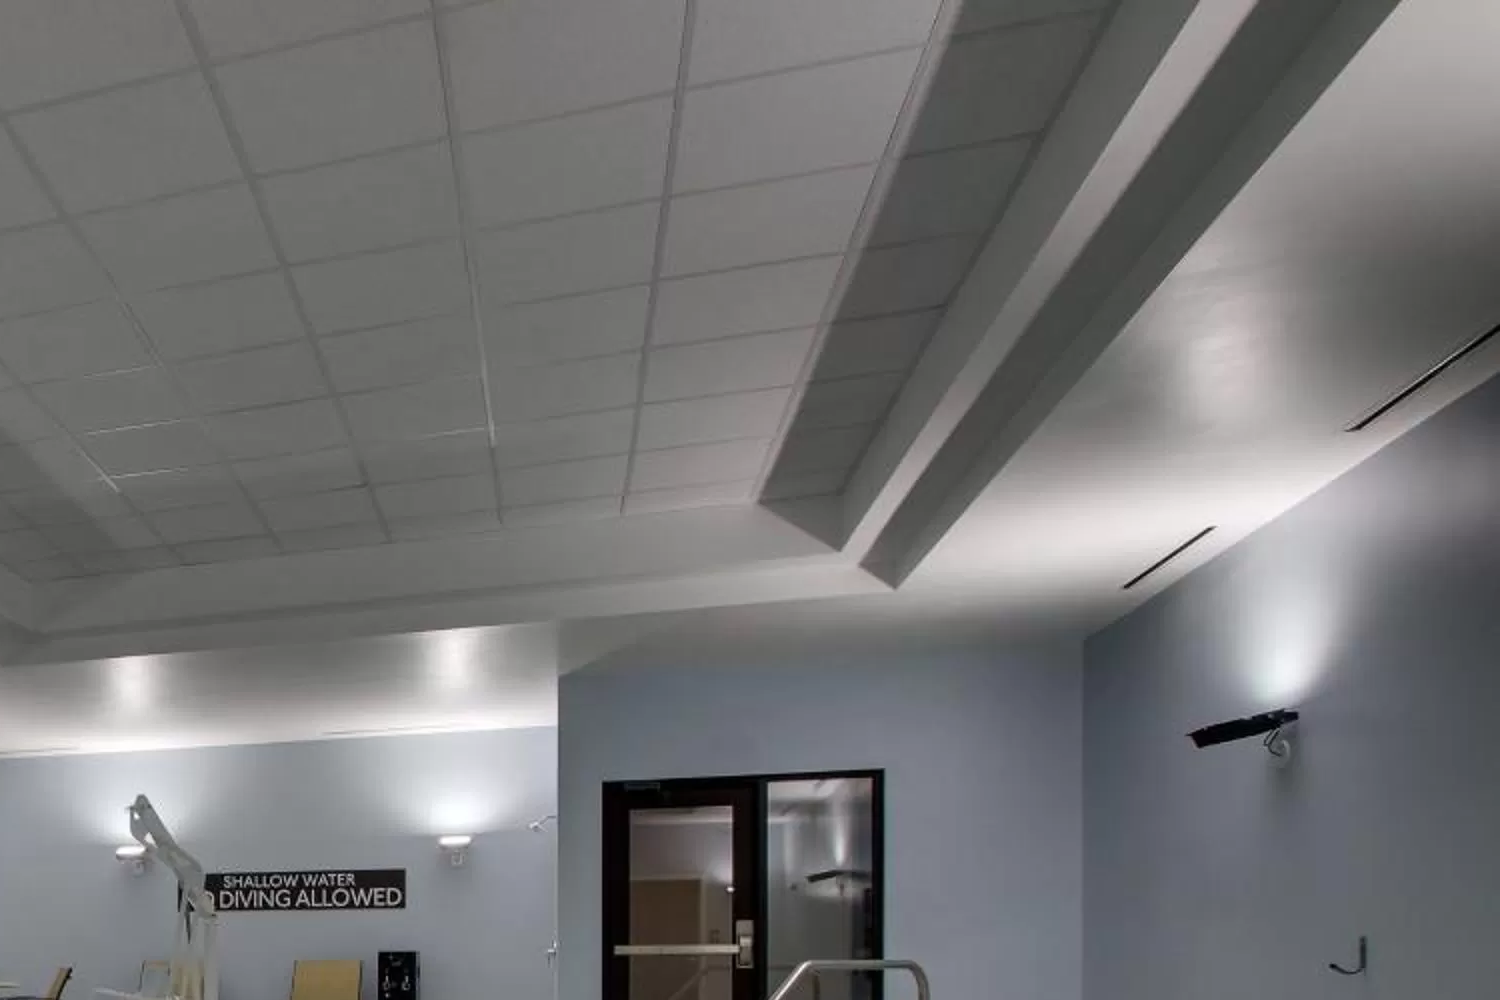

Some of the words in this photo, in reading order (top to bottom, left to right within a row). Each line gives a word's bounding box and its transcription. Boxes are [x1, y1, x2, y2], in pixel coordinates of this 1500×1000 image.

[223, 873, 299, 889] SHALLOW
[301, 872, 356, 888] WATER
[219, 889, 291, 909] DIVING
[295, 887, 402, 908] ALLOWED
